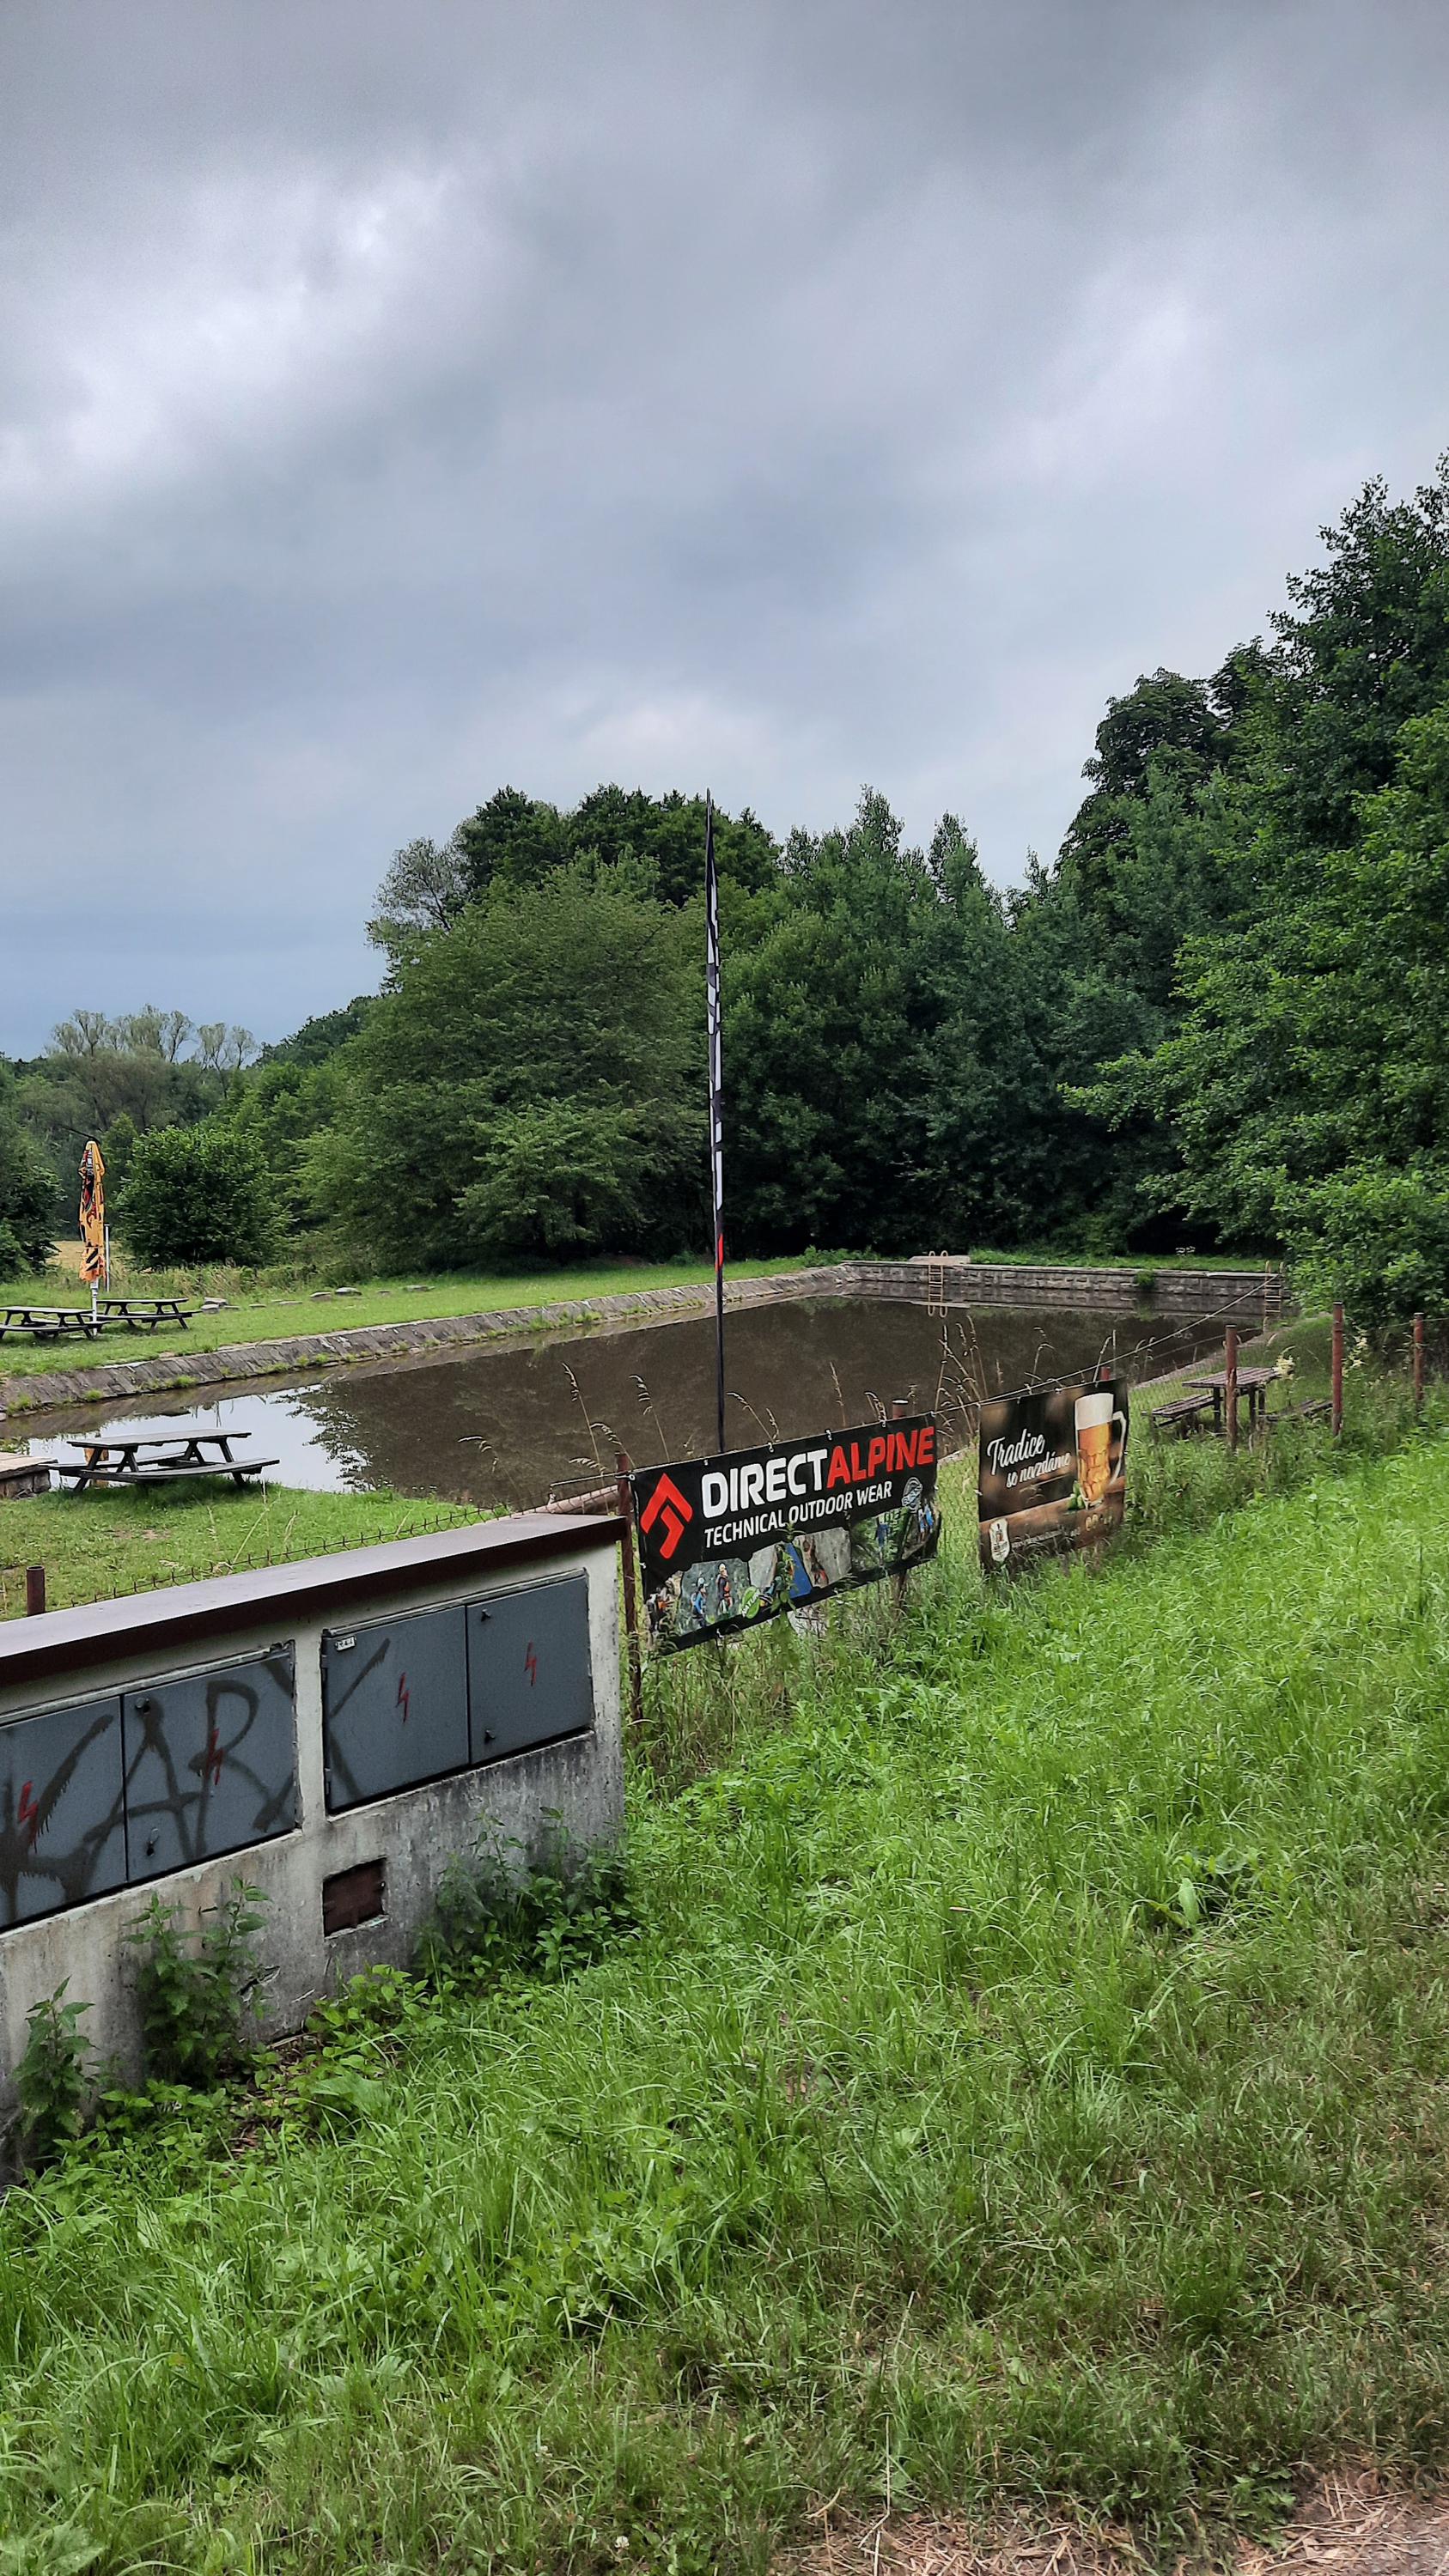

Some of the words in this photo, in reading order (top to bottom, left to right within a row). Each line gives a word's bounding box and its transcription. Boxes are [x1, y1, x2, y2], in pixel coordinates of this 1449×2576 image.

[987, 1428, 1046, 1475] Tradice
[1006, 1472, 1018, 1488] se
[1019, 1451, 1071, 1483] nevzdáme
[704, 1509, 791, 1548] TECHNICAL
[788, 1493, 853, 1524] OUTDOOR
[856, 1480, 892, 1507] WEAR
